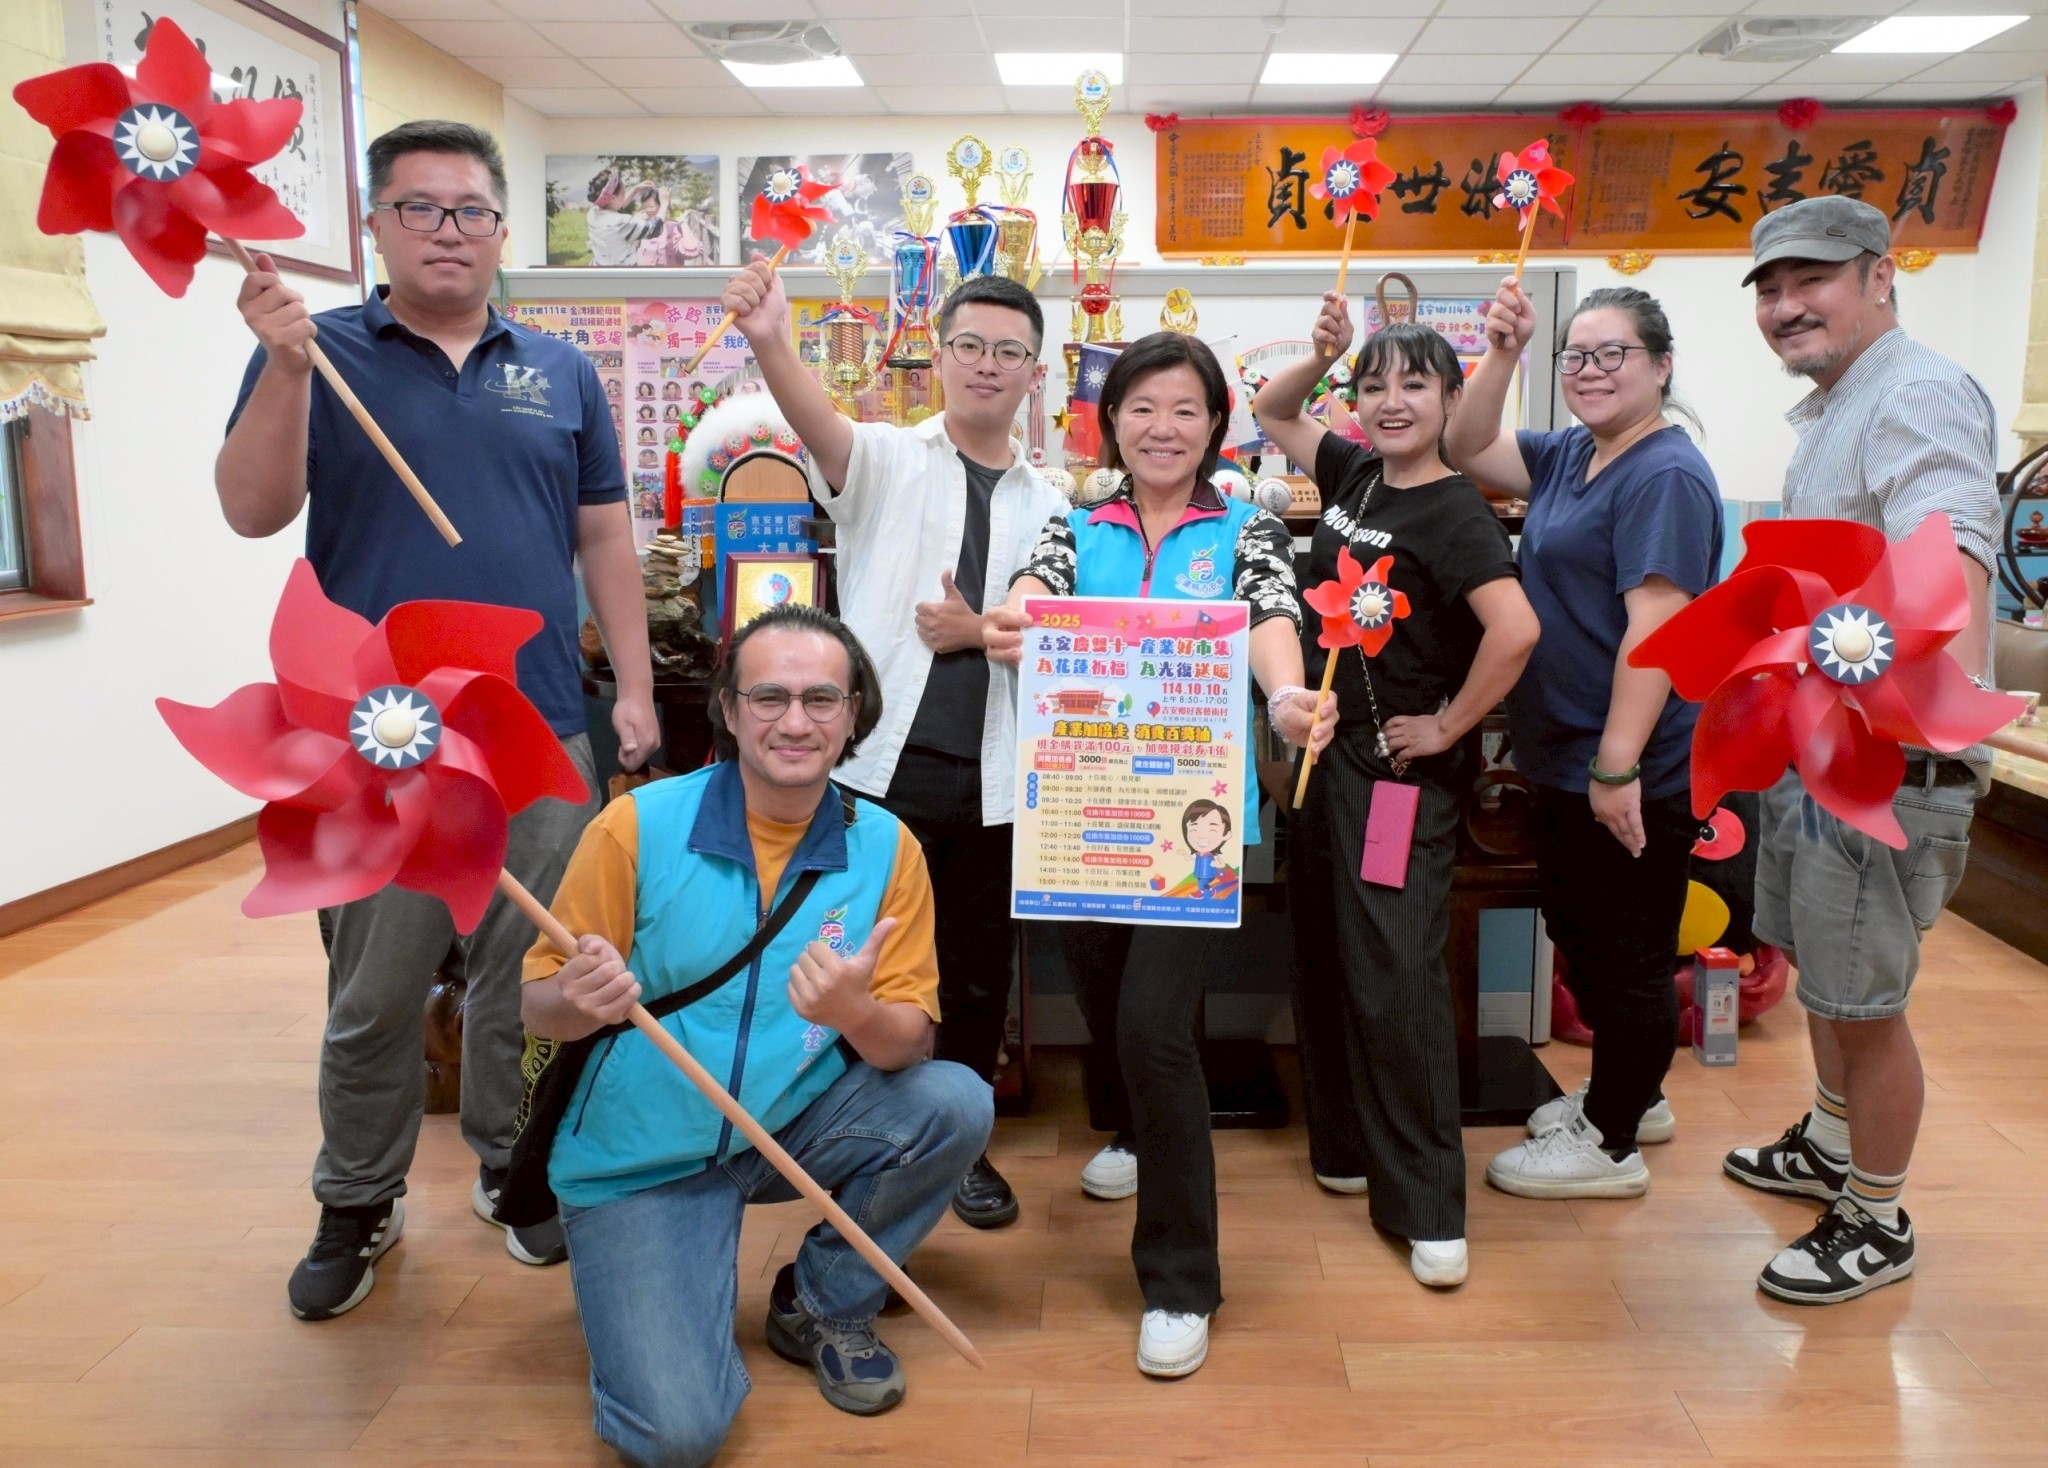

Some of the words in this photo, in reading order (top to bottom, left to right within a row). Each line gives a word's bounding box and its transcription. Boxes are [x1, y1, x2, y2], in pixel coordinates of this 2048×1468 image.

[751, 515, 783, 525] 吉安鄉
[1040, 613, 1081, 628] 2025
[1038, 635, 1126, 654] 吉安慶雙十
[1140, 638, 1231, 657] 產業好市集
[1037, 657, 1127, 676] 為花蓮祈福
[1139, 660, 1231, 680] 為光復送暖
